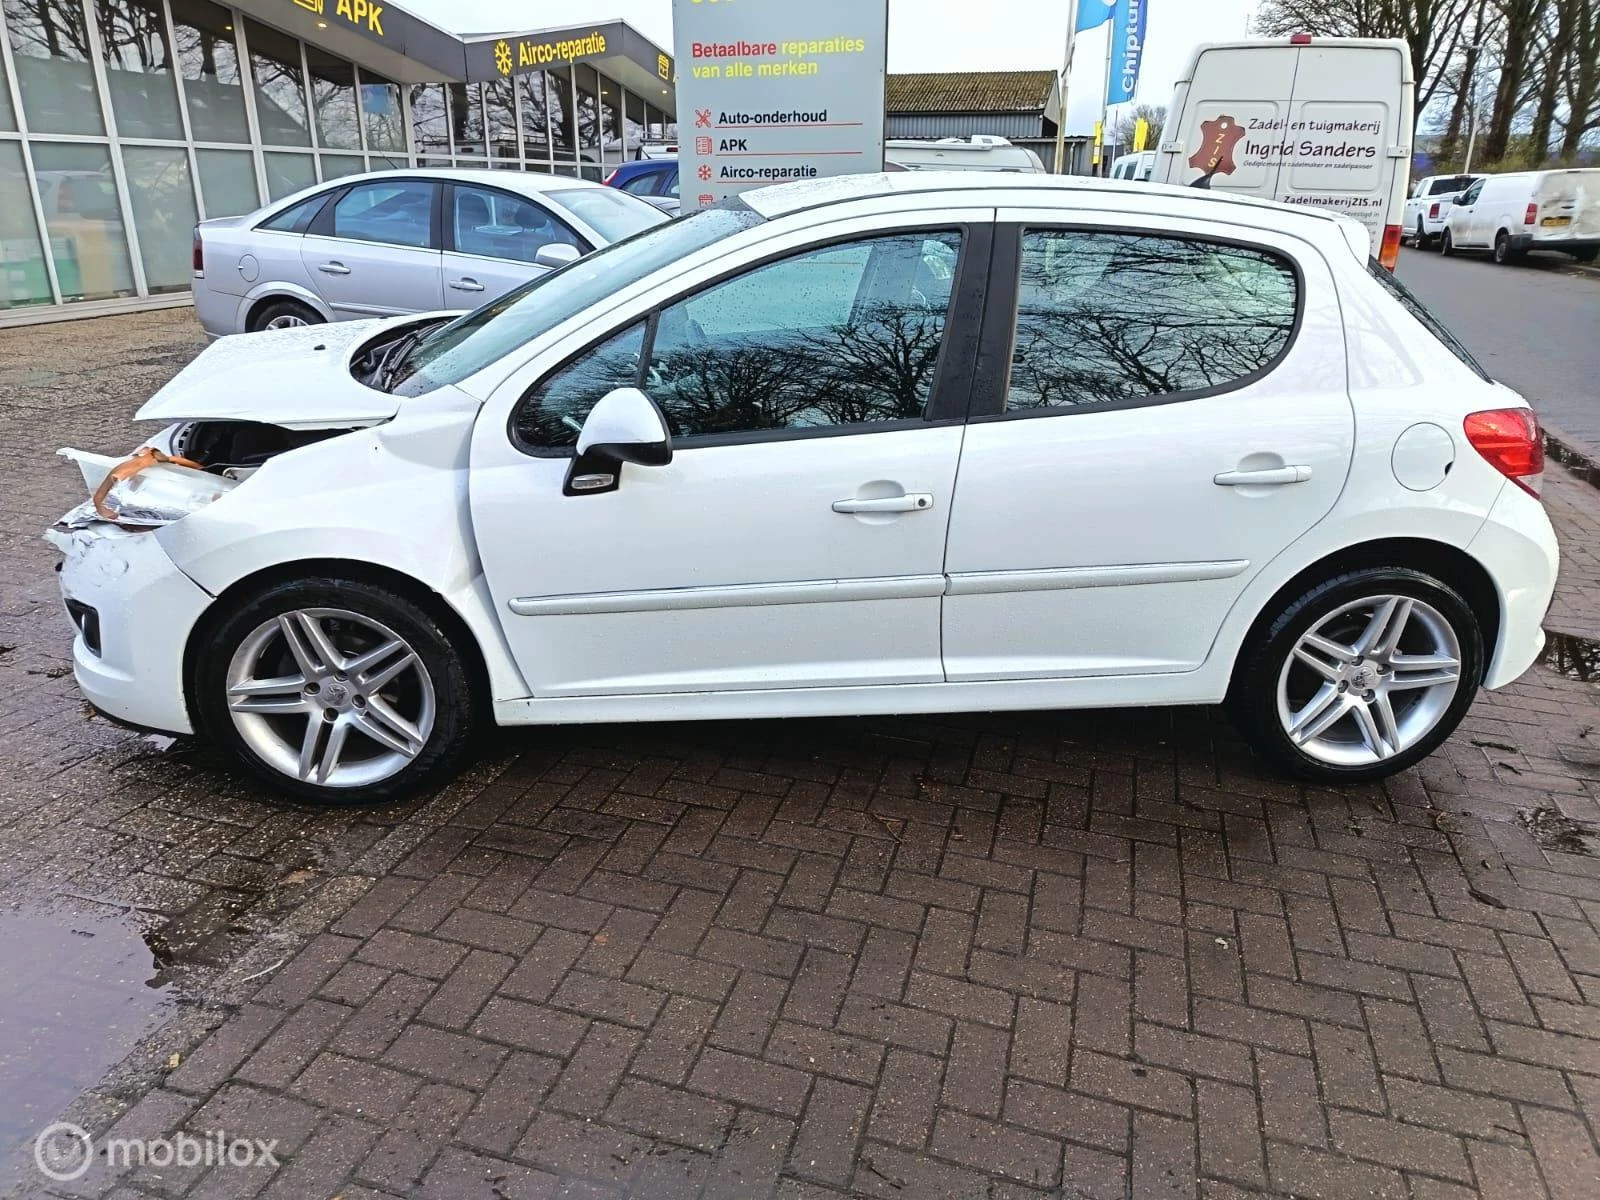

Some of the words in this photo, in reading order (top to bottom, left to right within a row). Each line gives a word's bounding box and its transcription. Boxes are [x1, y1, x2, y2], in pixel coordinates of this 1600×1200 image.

[336, 0, 384, 36] APK
[519, 31, 606, 67] Airco-reparatie
[692, 41, 777, 58] Betaalbare
[781, 36, 865, 58] reparaties
[692, 65, 720, 79] van
[725, 61, 753, 77] alle
[758, 60, 818, 77] merken
[718, 109, 827, 124] Auto-onderhoud
[1291, 121, 1306, 130] en
[1309, 120, 1381, 135] tuigmakerij
[719, 139, 748, 151] APK
[1207, 133, 1225, 168] ZIS
[1245, 140, 1295, 159] Ingrid
[1299, 140, 1376, 158] Sanders
[720, 165, 817, 180] Airco-reparatie
[1284, 196, 1382, 207] ZadelmakerijZIS.nl
